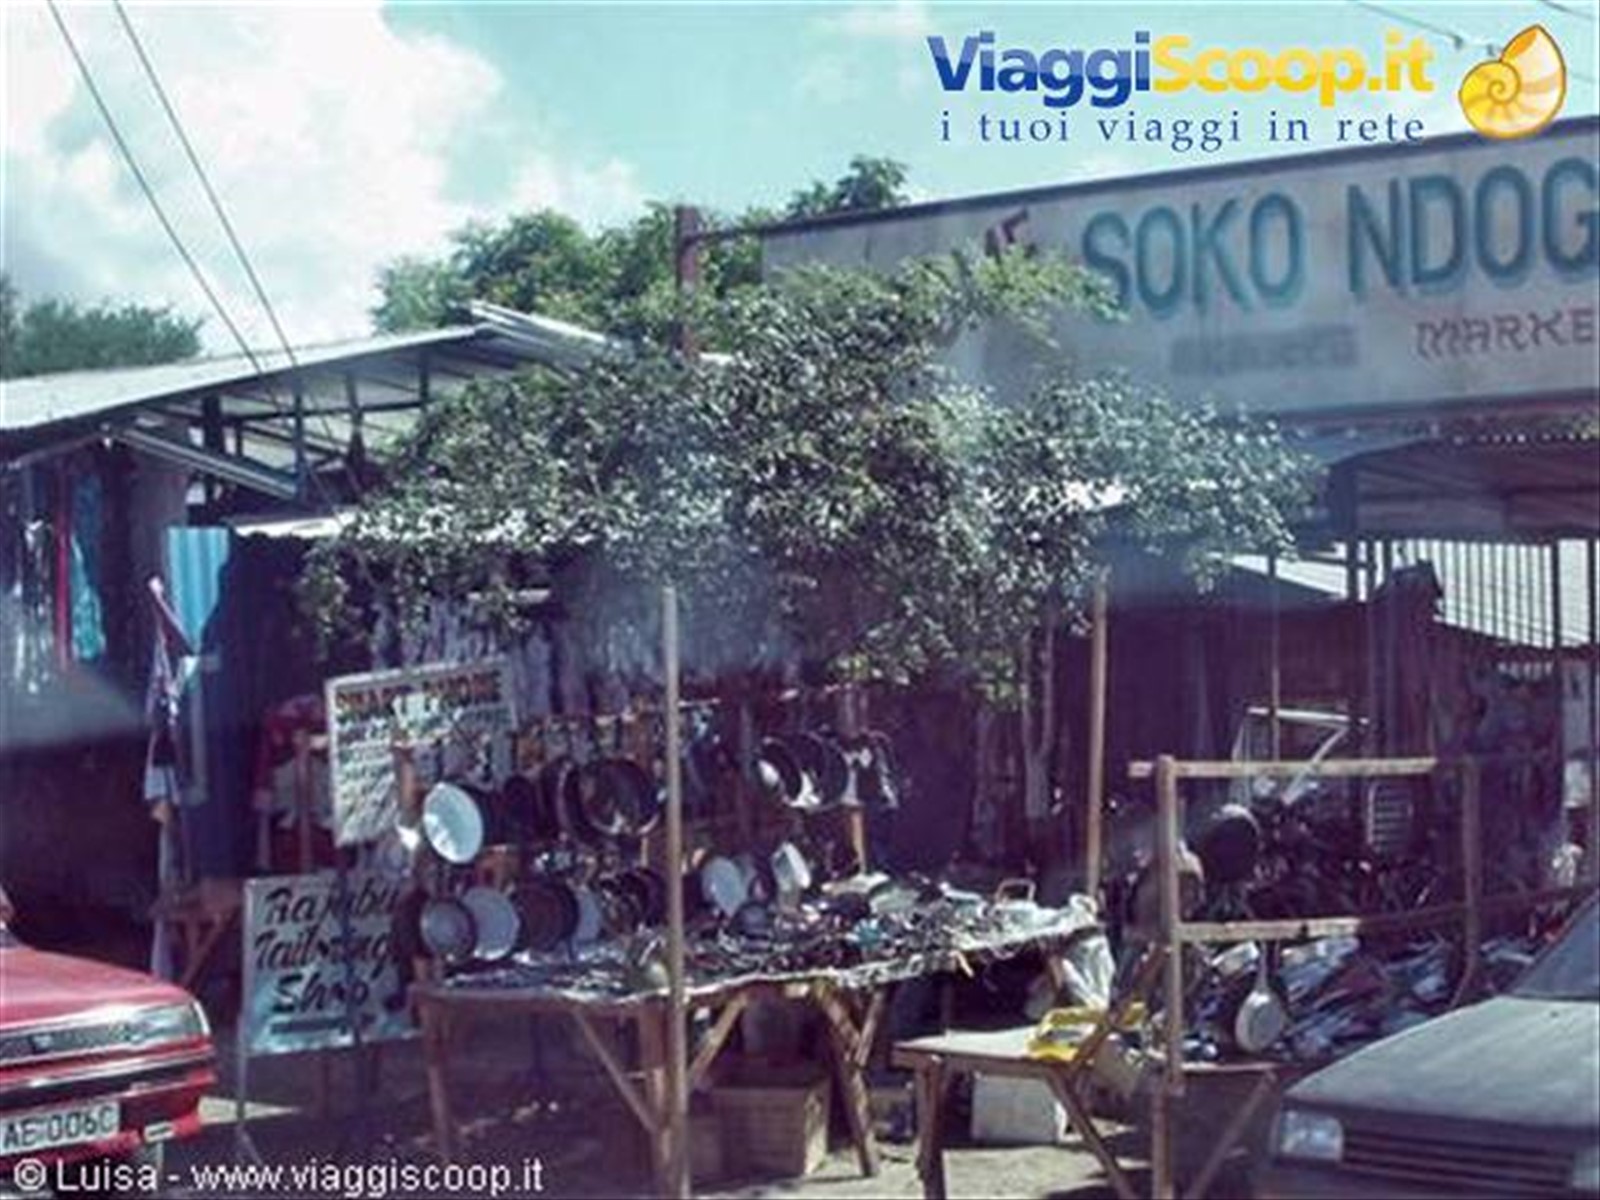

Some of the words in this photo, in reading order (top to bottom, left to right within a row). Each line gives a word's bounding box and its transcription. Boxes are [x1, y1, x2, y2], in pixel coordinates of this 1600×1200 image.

[1081, 192, 1304, 325] SOKO
[1346, 157, 1599, 294] NDOG
[1415, 308, 1595, 359] MARKE
